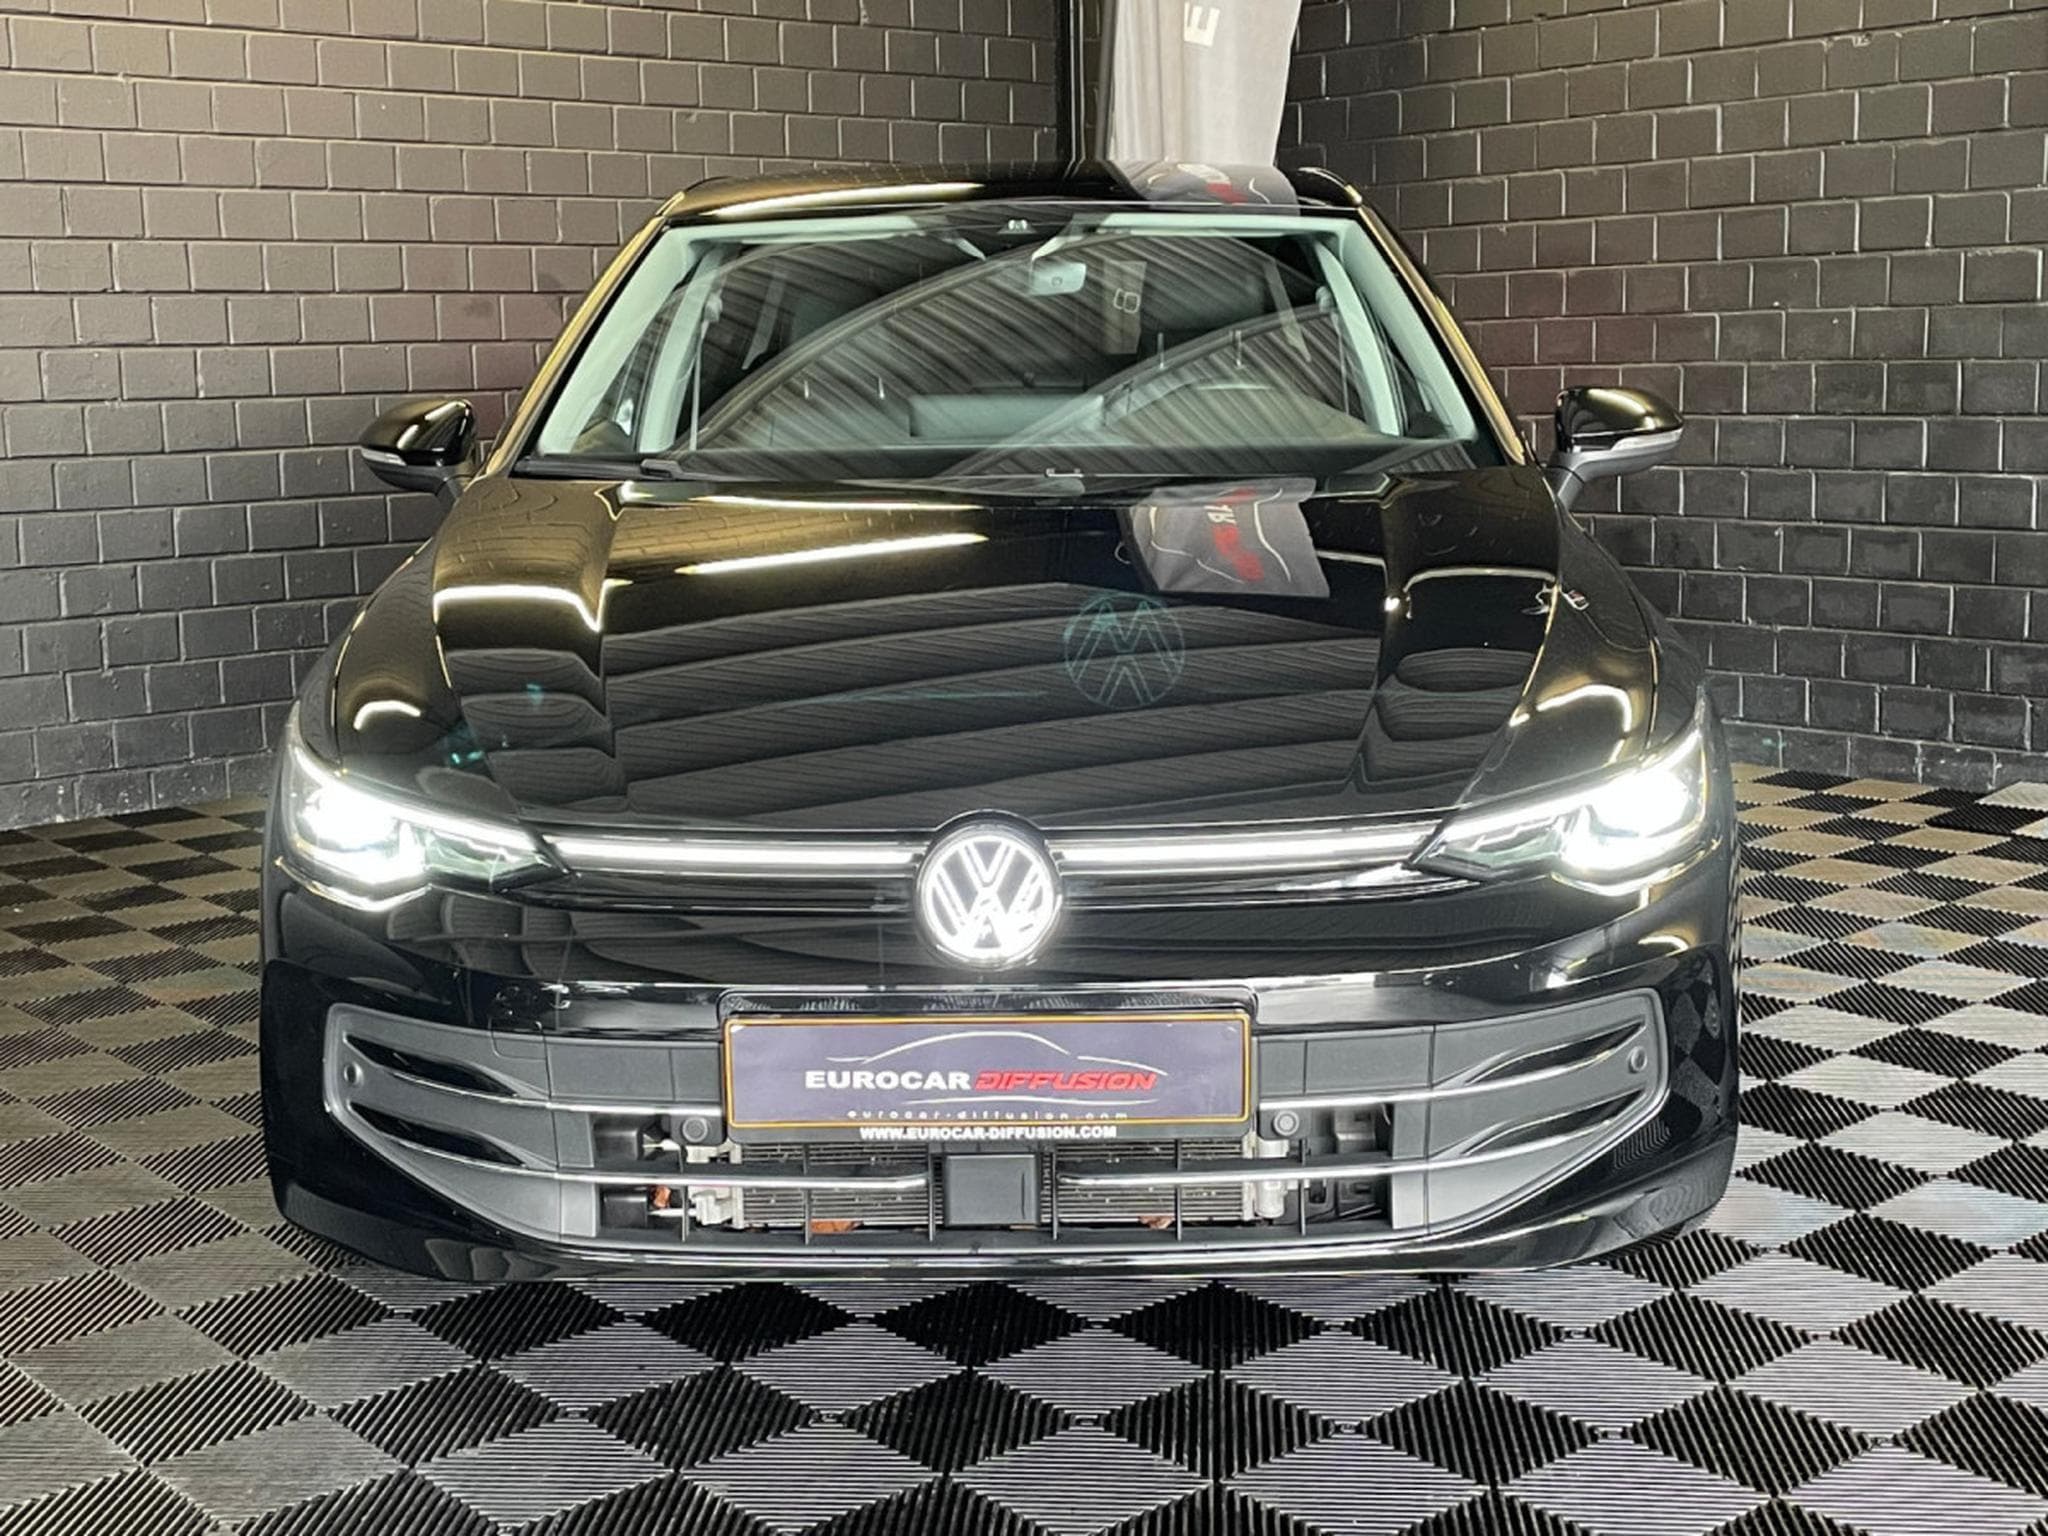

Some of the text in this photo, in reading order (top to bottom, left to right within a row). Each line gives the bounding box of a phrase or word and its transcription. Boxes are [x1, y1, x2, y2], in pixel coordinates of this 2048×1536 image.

[804, 1070, 1157, 1092] EUROCAR DIFFUSION
[859, 1126, 1117, 1141] WWW.EUROCAR-DIFFUSION.COM
